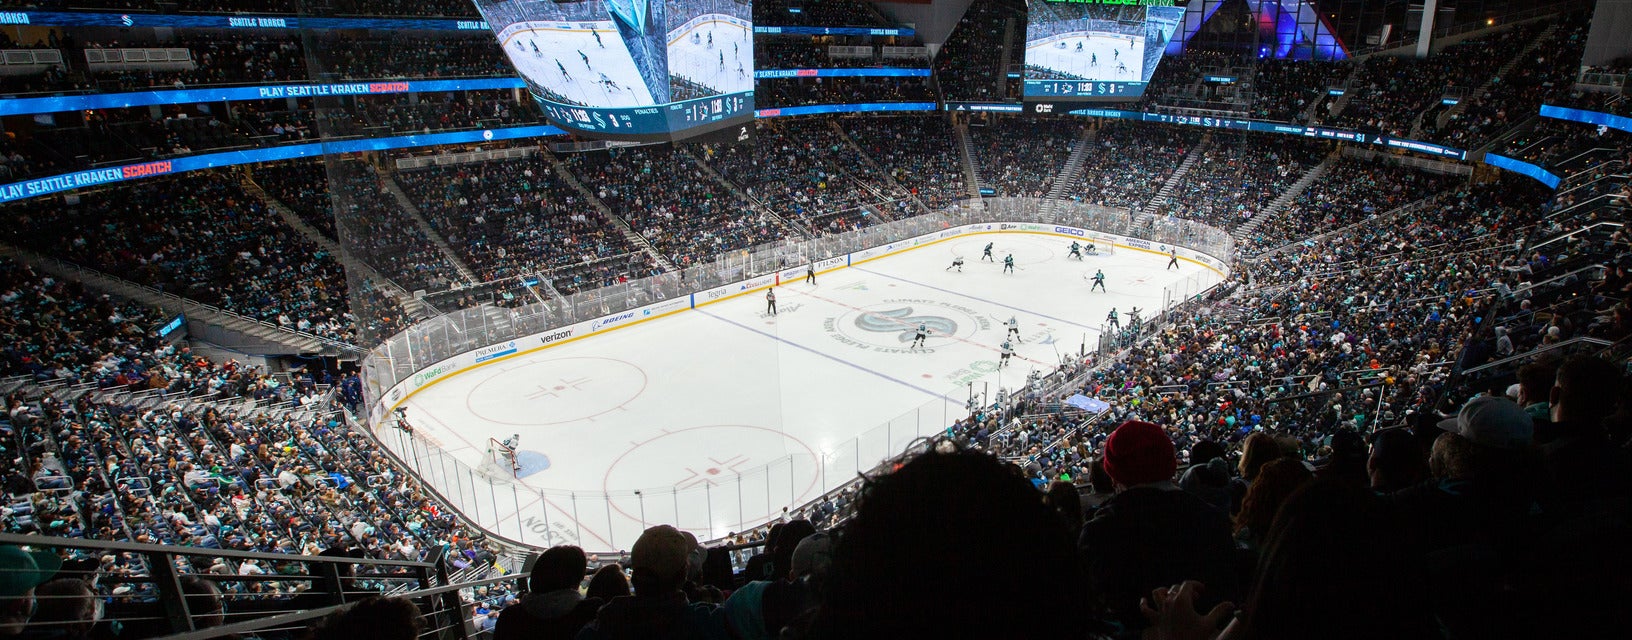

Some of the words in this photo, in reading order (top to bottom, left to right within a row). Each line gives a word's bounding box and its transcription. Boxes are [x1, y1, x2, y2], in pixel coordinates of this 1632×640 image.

[0, 12, 30, 24] RAKEN
[229, 17, 257, 27] SEATTLE
[258, 17, 286, 27] KRAKEN
[259, 87, 284, 97] PLAY
[287, 86, 329, 96] SEATTLE
[330, 84, 369, 95] KRAKEN
[369, 82, 409, 93] SCRATCH
[0, 184, 23, 200] LAY
[26, 174, 75, 195] SEATTLE
[74, 168, 123, 185] KRAKEN
[122, 161, 172, 178] SCRATCH
[1055, 226, 1085, 237] GEICO
[1125, 238, 1151, 246] AMERICAN
[1128, 242, 1151, 250] EXPRESS
[817, 257, 844, 269] FILSON
[708, 288, 727, 299] Tegria
[602, 313, 635, 325] BOEING
[541, 330, 572, 343] verizon
[475, 344, 507, 357] PREMERA
[423, 368, 442, 380] WaFd
[441, 362, 457, 373] Bank
